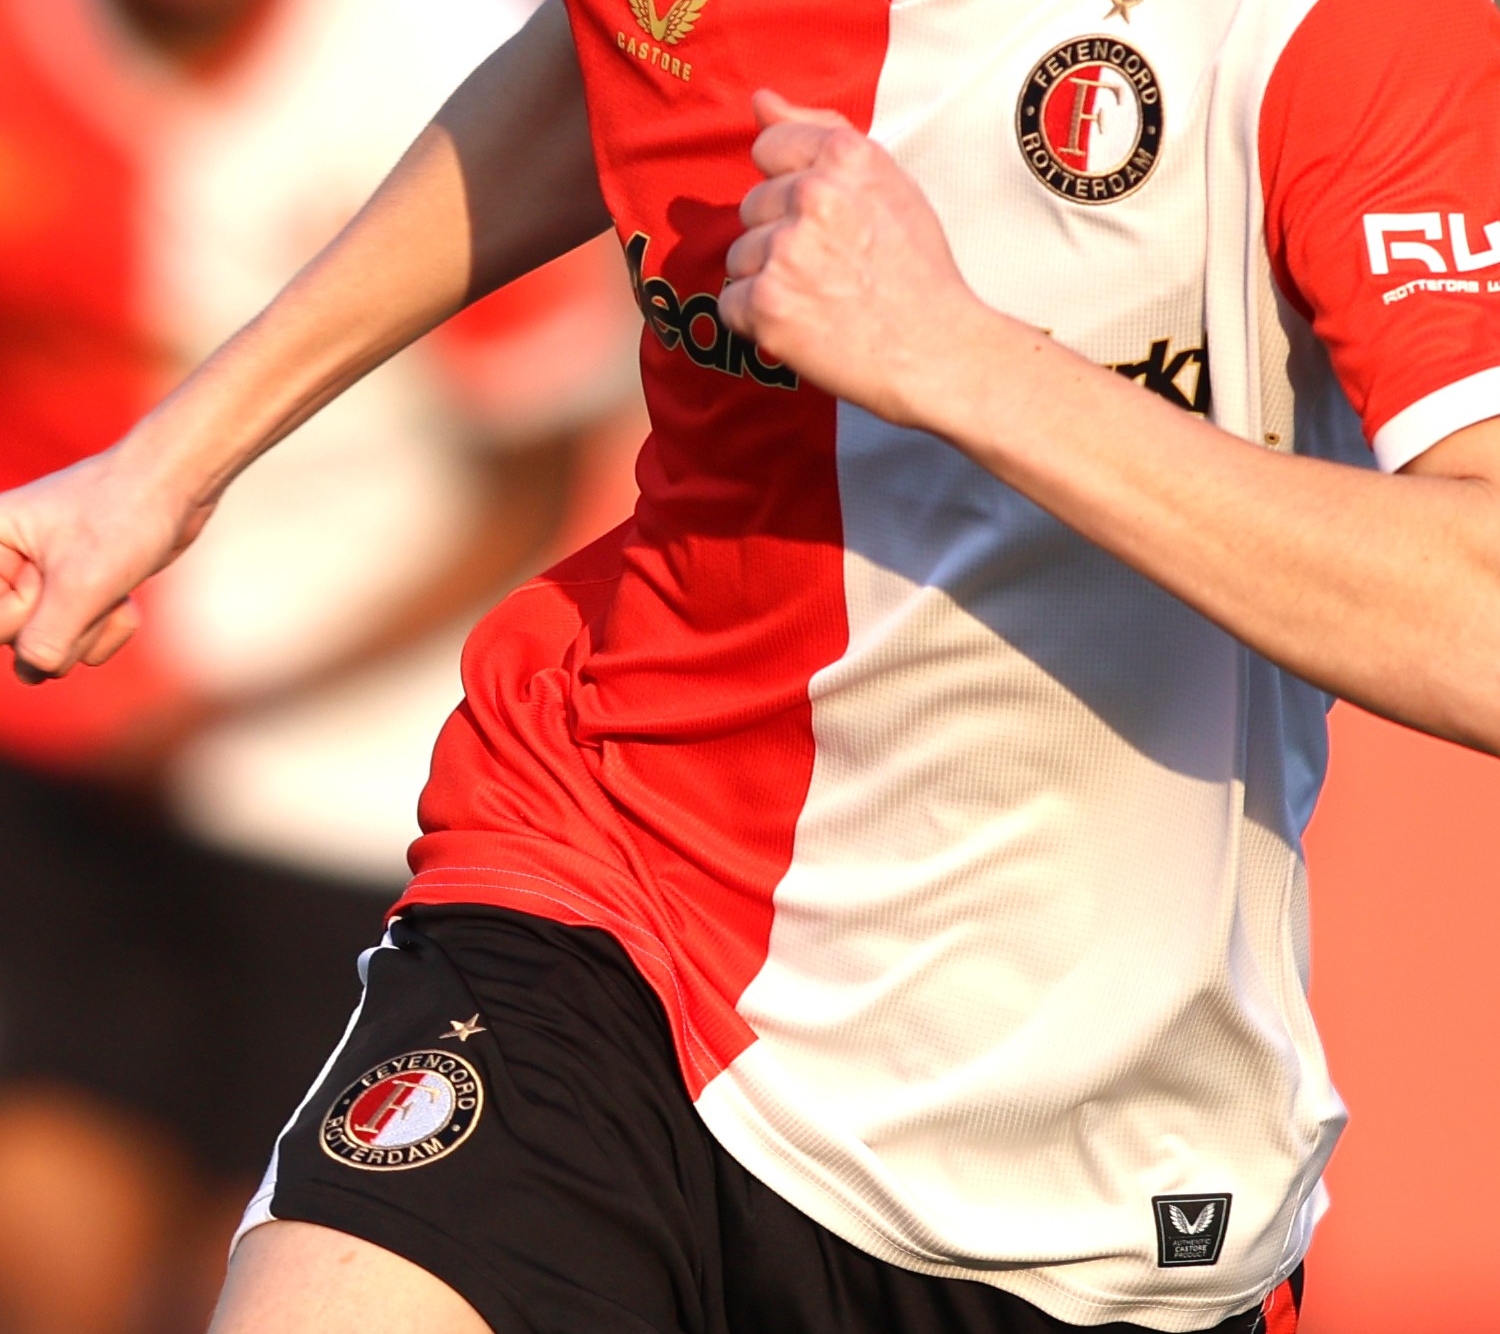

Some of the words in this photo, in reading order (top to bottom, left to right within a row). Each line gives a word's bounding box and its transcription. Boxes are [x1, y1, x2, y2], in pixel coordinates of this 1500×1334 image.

[617, 31, 693, 82] CASTORE
[1033, 40, 1158, 105] FEYENOORD
[1069, 77, 1121, 156] F
[1022, 146, 1155, 198] ROTTERDAM
[1382, 278, 1480, 306] ROTTERDAM
[361, 1054, 476, 1111] FEYENOORD
[326, 1115, 445, 1165] ROTTERDAM
[1175, 1244, 1208, 1253] CASTORE
